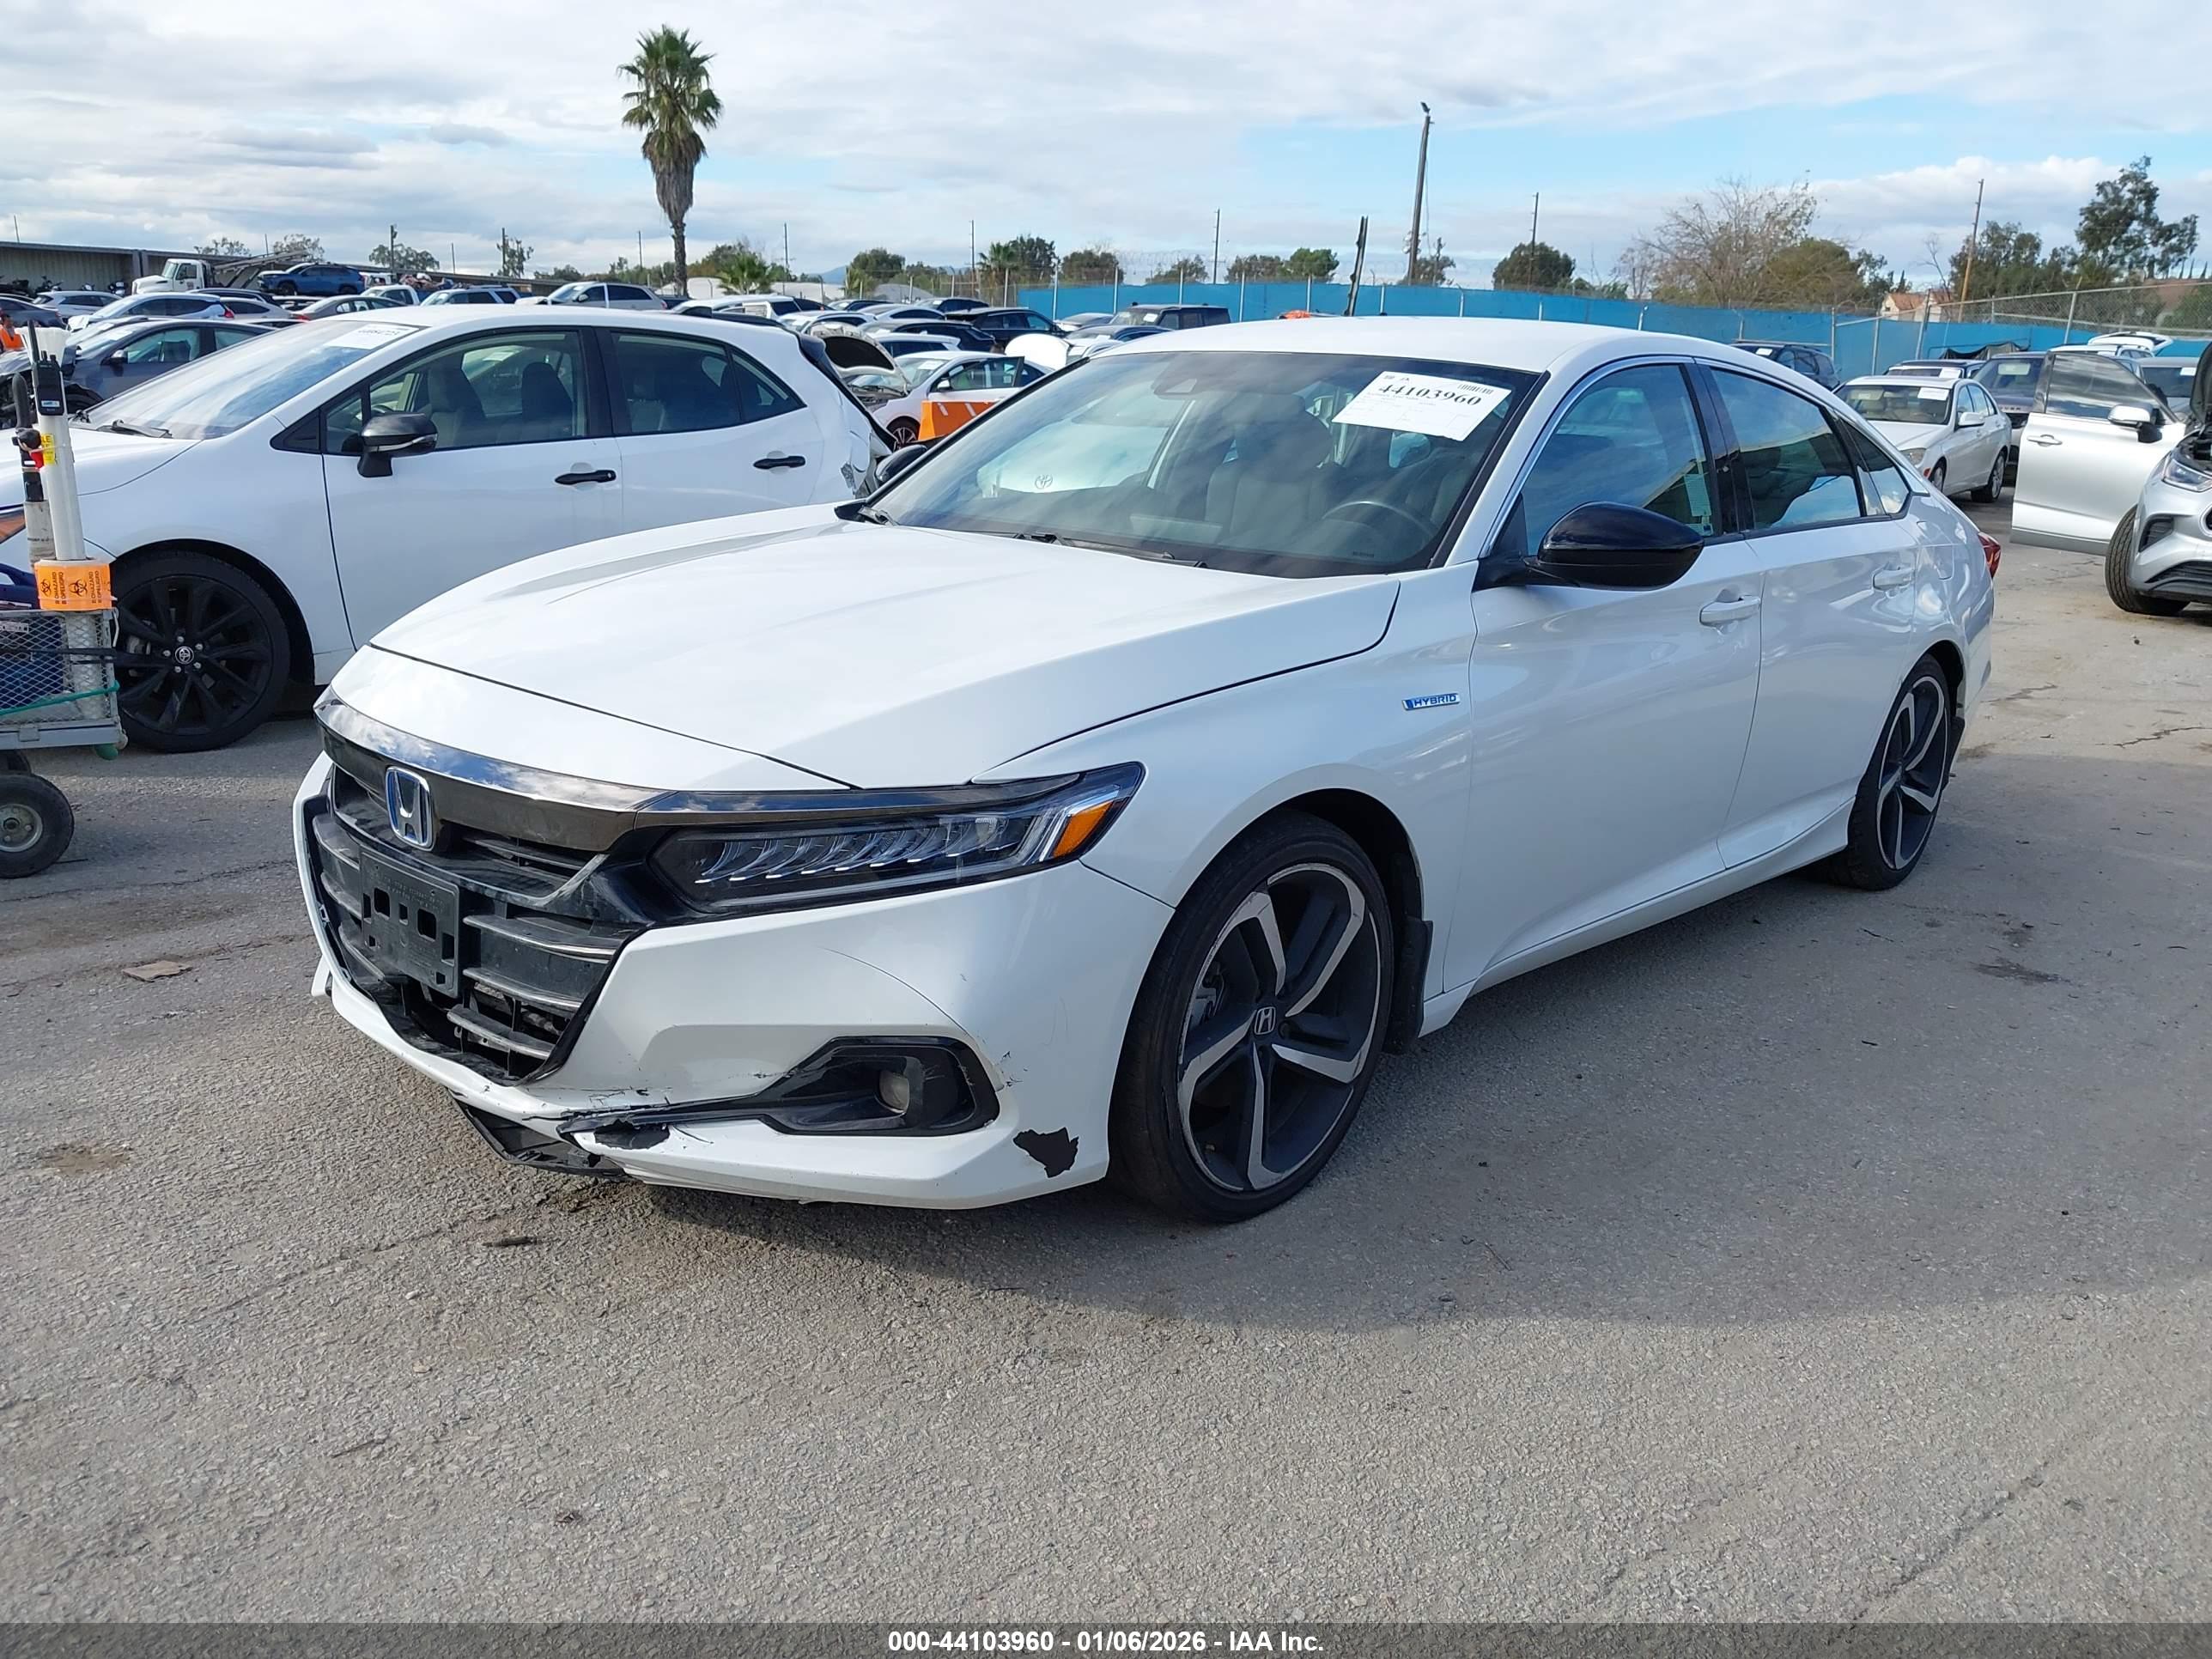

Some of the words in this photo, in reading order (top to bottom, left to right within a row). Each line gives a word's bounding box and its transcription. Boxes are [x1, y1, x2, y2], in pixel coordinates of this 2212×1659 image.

[1378, 384, 1481, 405] 44103960
[52, 571, 60, 605] BOHAZARD
[58, 571, 67, 605] BOPELIGRO
[1413, 694, 1457, 707] HYBRID
